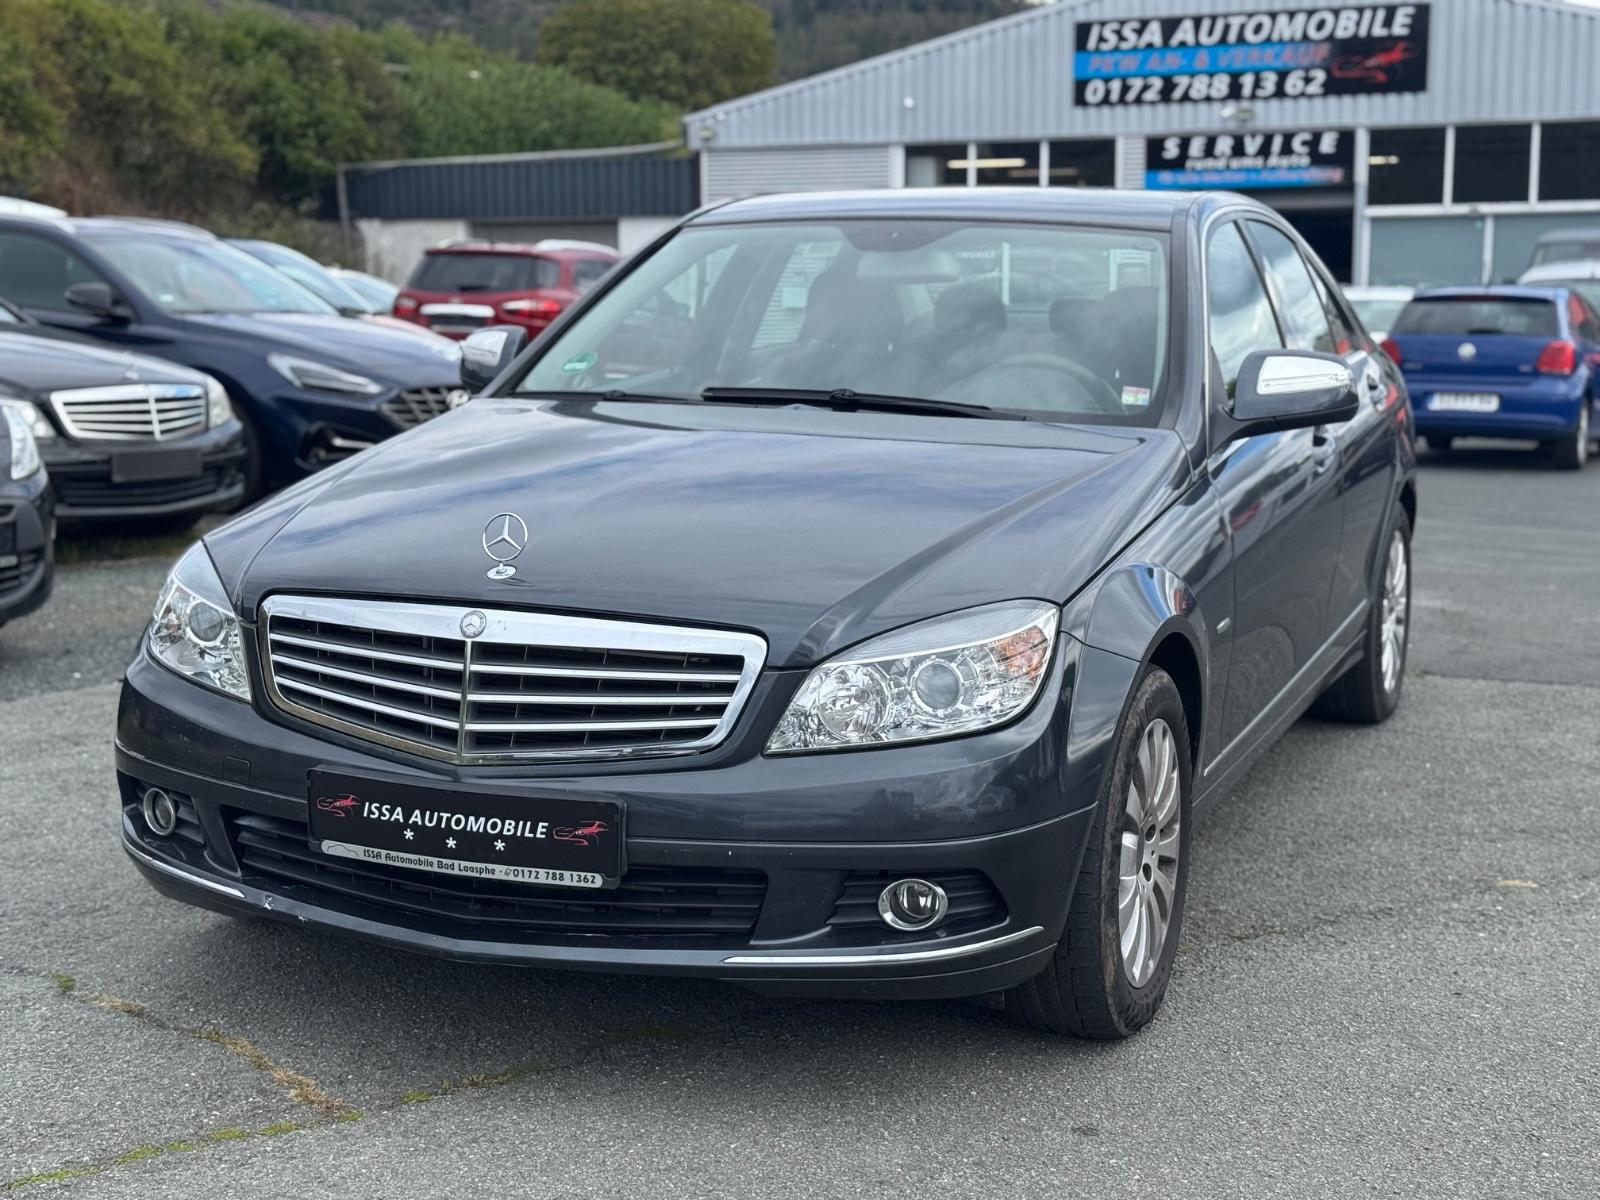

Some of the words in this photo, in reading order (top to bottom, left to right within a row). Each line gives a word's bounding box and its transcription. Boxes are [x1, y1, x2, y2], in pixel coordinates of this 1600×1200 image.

[1087, 20, 1163, 50] ISSA
[1169, 7, 1416, 47] AUTOMOBILE
[1084, 76, 1164, 105] 0172
[1170, 72, 1232, 100] 788
[1238, 71, 1280, 98] 13
[1283, 69, 1327, 97] 62
[1161, 131, 1340, 160] SERVICE
[363, 802, 404, 823] ISSA
[409, 809, 549, 838] AUTOMOBILE
[363, 848, 382, 860] ISSA
[385, 852, 434, 868] Automobile
[437, 860, 455, 871] Bad
[458, 863, 496, 876] Laasphe
[512, 868, 540, 880] 0172
[544, 871, 565, 881] 788
[569, 873, 597, 884] 1362
